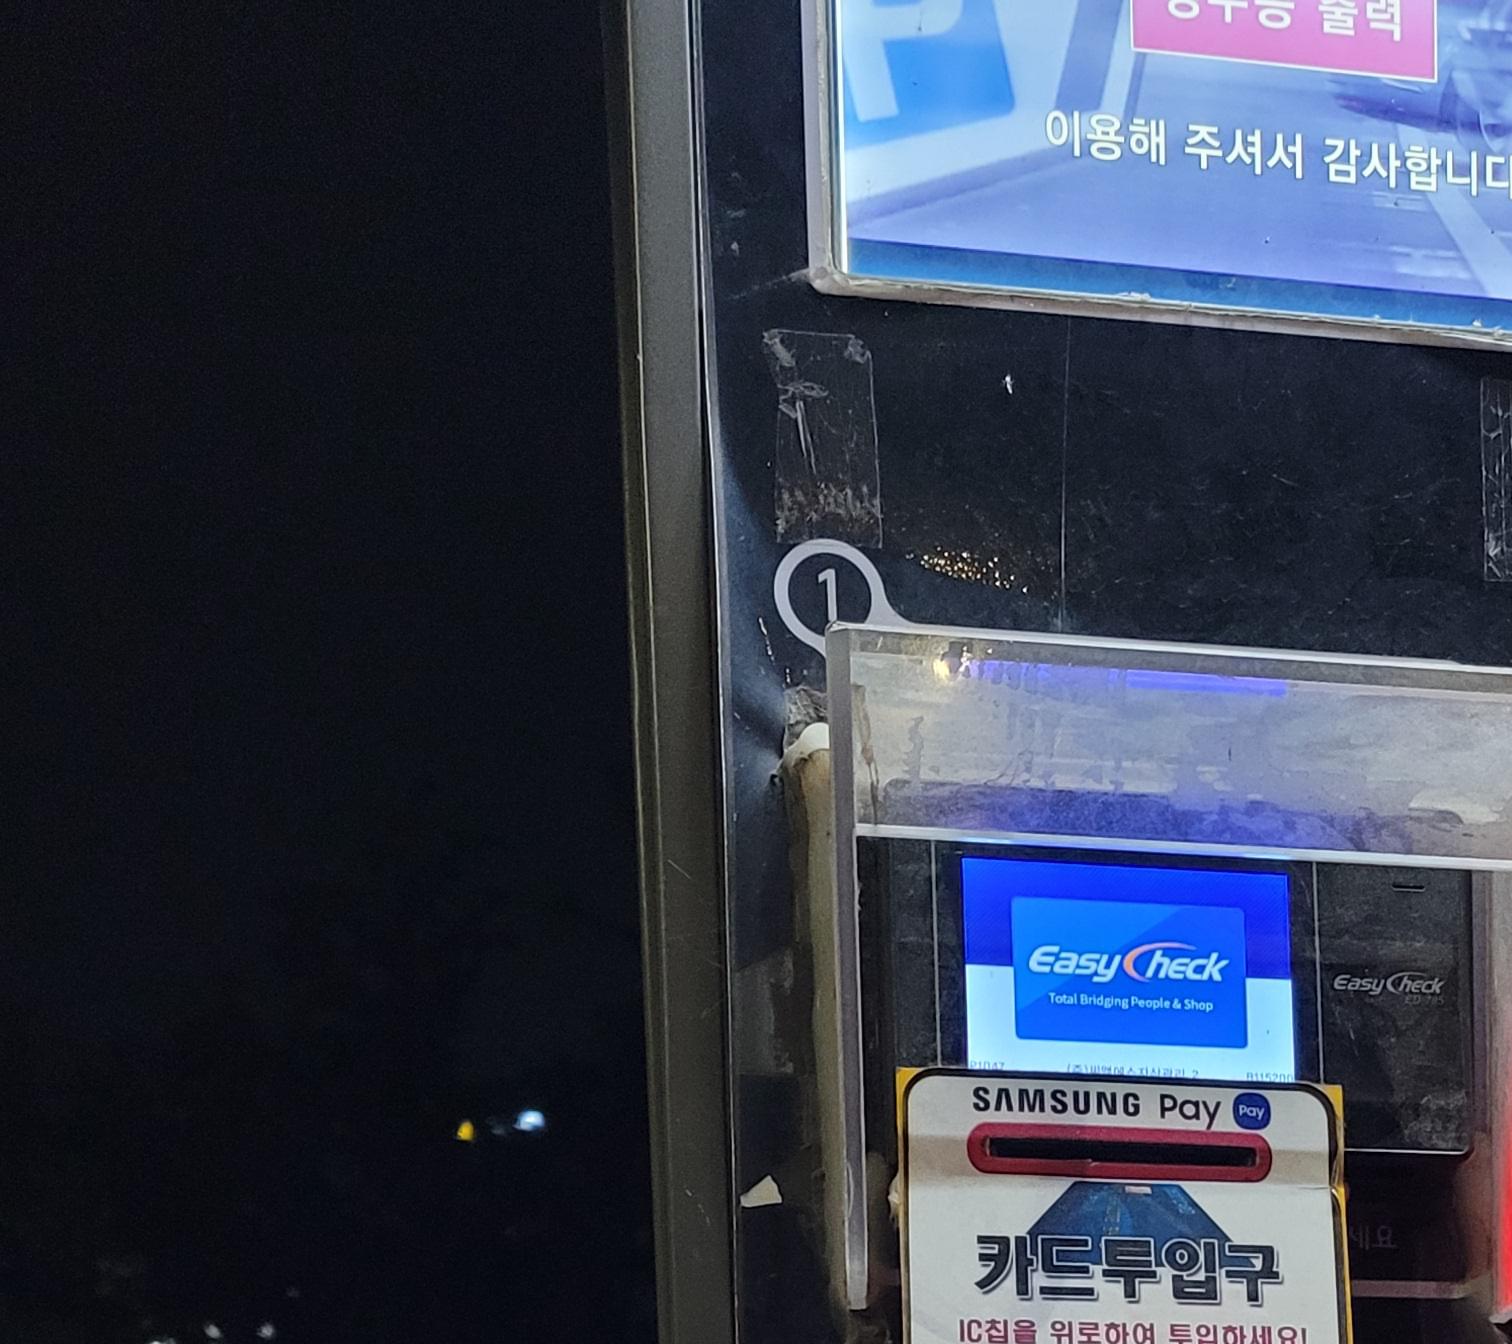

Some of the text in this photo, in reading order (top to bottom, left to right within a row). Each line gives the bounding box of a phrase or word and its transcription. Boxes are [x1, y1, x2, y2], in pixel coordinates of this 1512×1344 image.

[1045, 109, 1168, 166] 이용해
[1183, 121, 1305, 180] 주셔서
[1027, 942, 1230, 983] EasyCheck
[1333, 972, 1446, 995] EasyCheck
[1048, 992, 1214, 1013] Total Bridging People Shop
[972, 1086, 1221, 1130] SAMSUNG Pay
[1239, 1104, 1264, 1120] Pay
[975, 1233, 1281, 1305] 카드투입구
[959, 1319, 1037, 1344] IC칩을
